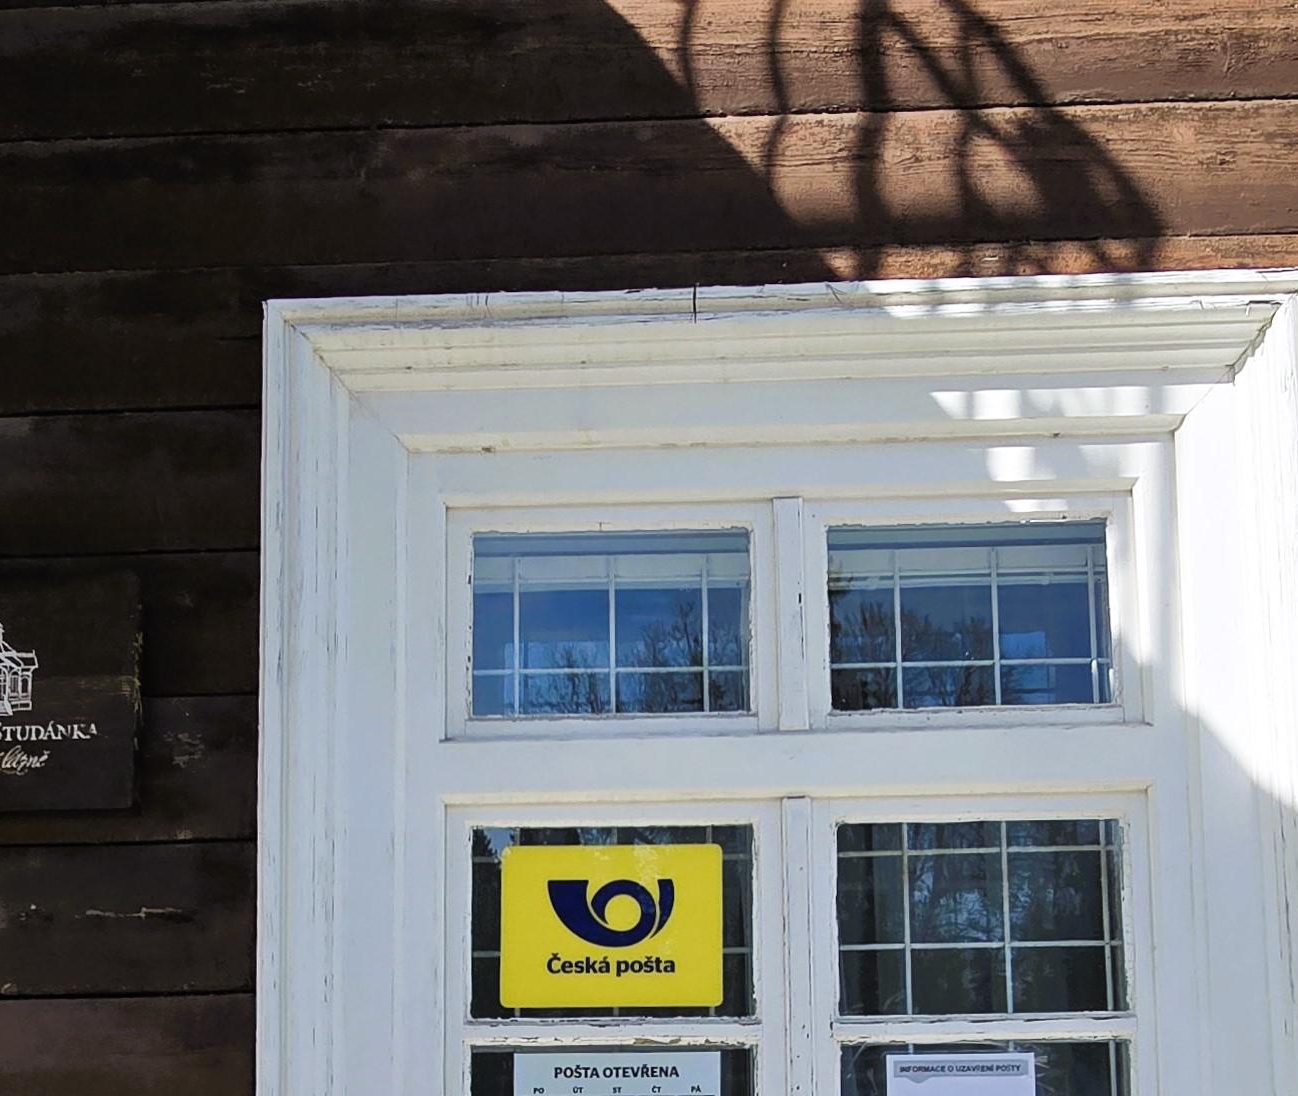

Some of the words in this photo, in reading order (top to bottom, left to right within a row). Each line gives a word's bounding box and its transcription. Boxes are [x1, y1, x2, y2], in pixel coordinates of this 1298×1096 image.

[547, 952, 611, 975] Česká
[616, 956, 676, 977] pošta
[554, 1065, 600, 1079] POŠTA
[603, 1064, 680, 1079] OTEVŘENA
[900, 1065, 946, 1073] INFORMACE
[533, 1087, 545, 1095] PO
[573, 1086, 584, 1094] ÚT
[612, 1086, 622, 1094] ST
[651, 1084, 662, 1094] ČT
[690, 1084, 702, 1093] PÁ
